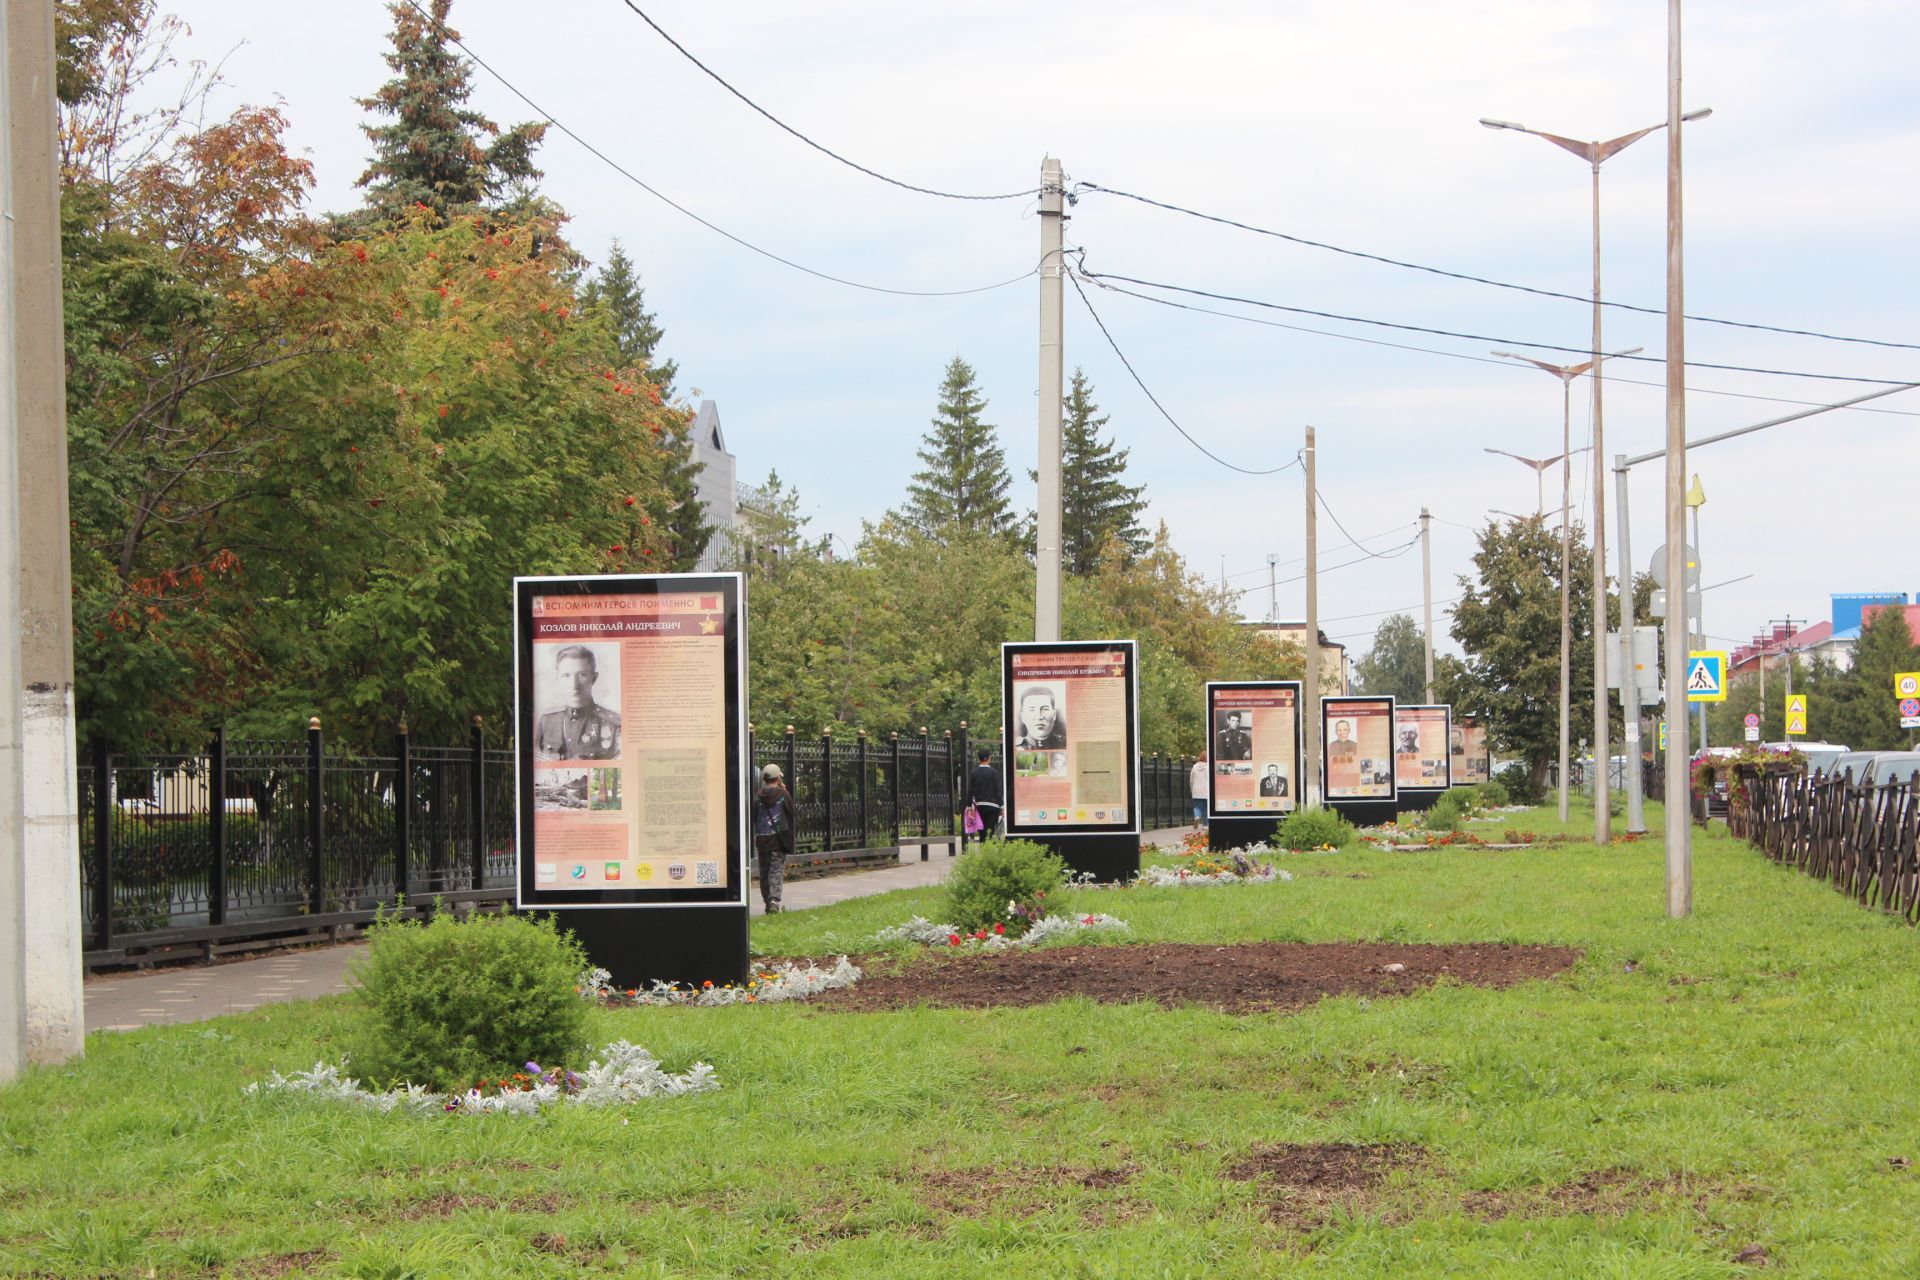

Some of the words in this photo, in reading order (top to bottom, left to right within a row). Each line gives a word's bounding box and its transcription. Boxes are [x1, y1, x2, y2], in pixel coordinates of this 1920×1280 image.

[604, 600, 637, 609] ГЕРОЕВ
[639, 599, 695, 609] ПОИМЕННО
[540, 623, 577, 632] КОЗЛОВ
[579, 621, 624, 631] НИКОЛАЙ
[625, 620, 681, 631] АНДРЕЕВИЧ
[1902, 681, 1915, 690] 40
